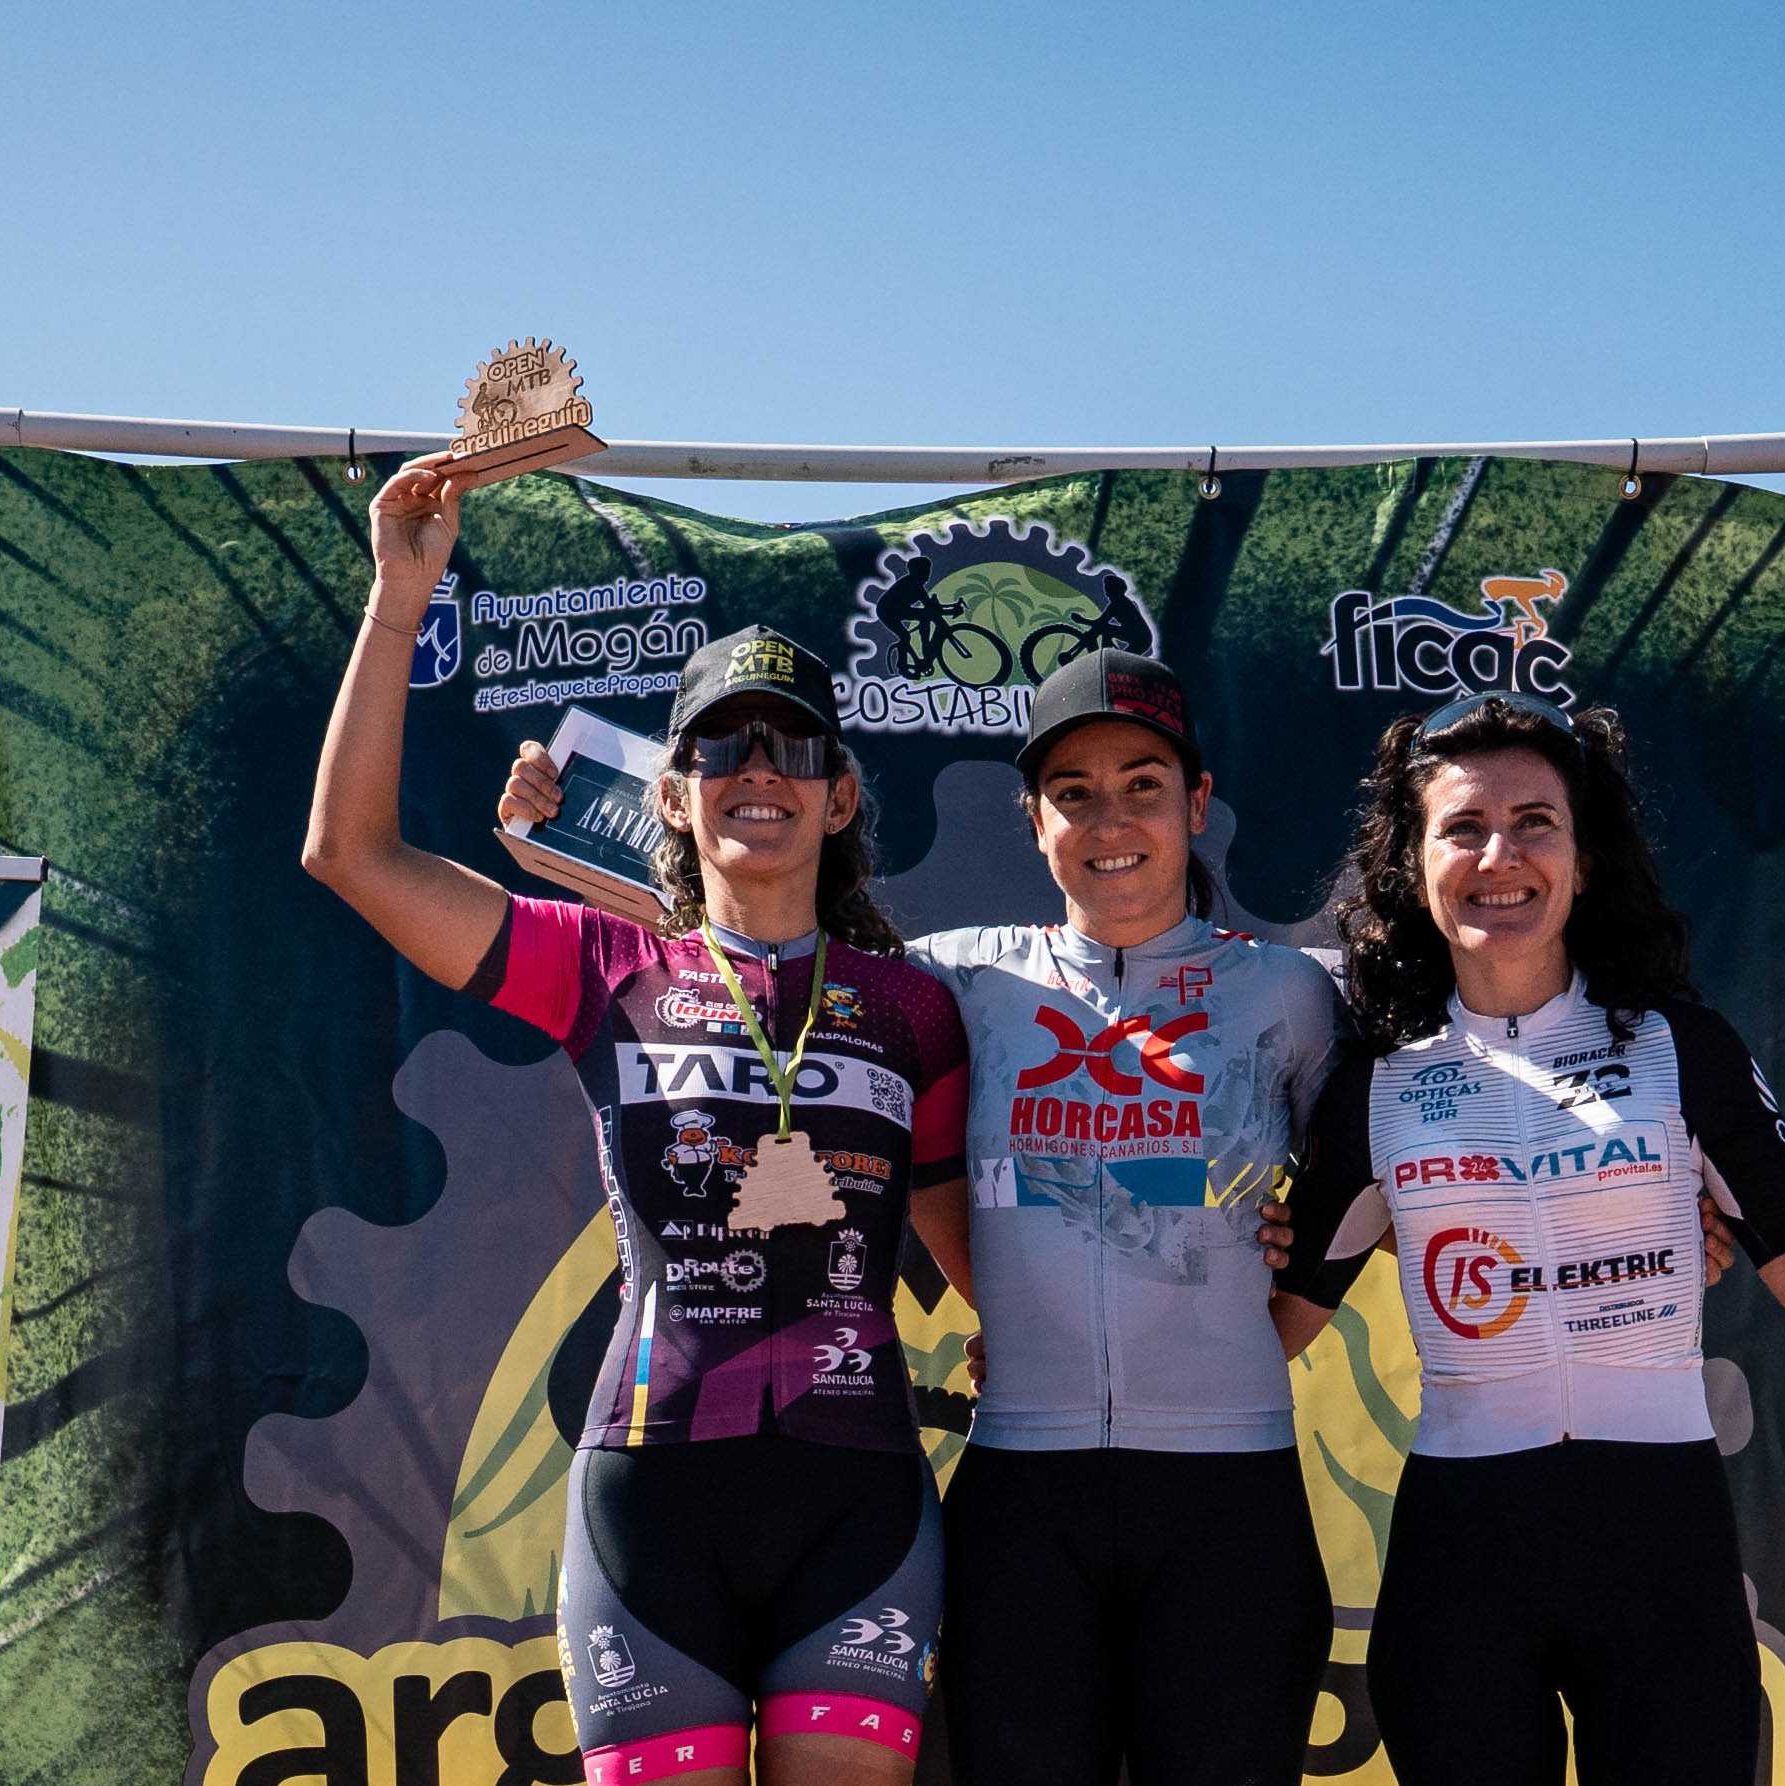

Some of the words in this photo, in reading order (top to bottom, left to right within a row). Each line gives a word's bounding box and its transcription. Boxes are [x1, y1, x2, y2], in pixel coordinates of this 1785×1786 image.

[487, 350, 544, 382] OPEN
[508, 369, 551, 396] MTB
[473, 577, 705, 627] Ayuntamiento
[477, 646, 511, 675] de
[518, 611, 707, 671] Mogán
[731, 639, 794, 659] OPEN
[725, 654, 794, 680] MTB
[475, 673, 681, 711] #EresloquetePropon
[678, 970, 743, 984] FASTR
[1553, 1045, 1626, 1069] BIORACER
[1420, 1099, 1458, 1112] DEL
[1010, 1097, 1202, 1143] HORCASA
[1422, 1109, 1458, 1124] SUR
[1009, 1137, 1100, 1157] HORMIGONES
[1395, 1137, 1661, 1189] PRVITAL
[1598, 1163, 1663, 1181] provital.es
[686, 1307, 762, 1319] MAPFRE
[806, 1298, 840, 1309] SANTA
[1565, 1308, 1655, 1333] THREELINE
[812, 1374, 847, 1385] SANTA
[829, 1644, 874, 1661] SANTA
[826, 1659, 860, 1670] ATENEO
[863, 1664, 906, 1682] MUNICIPAL
[589, 1697, 621, 1714] SANTA
